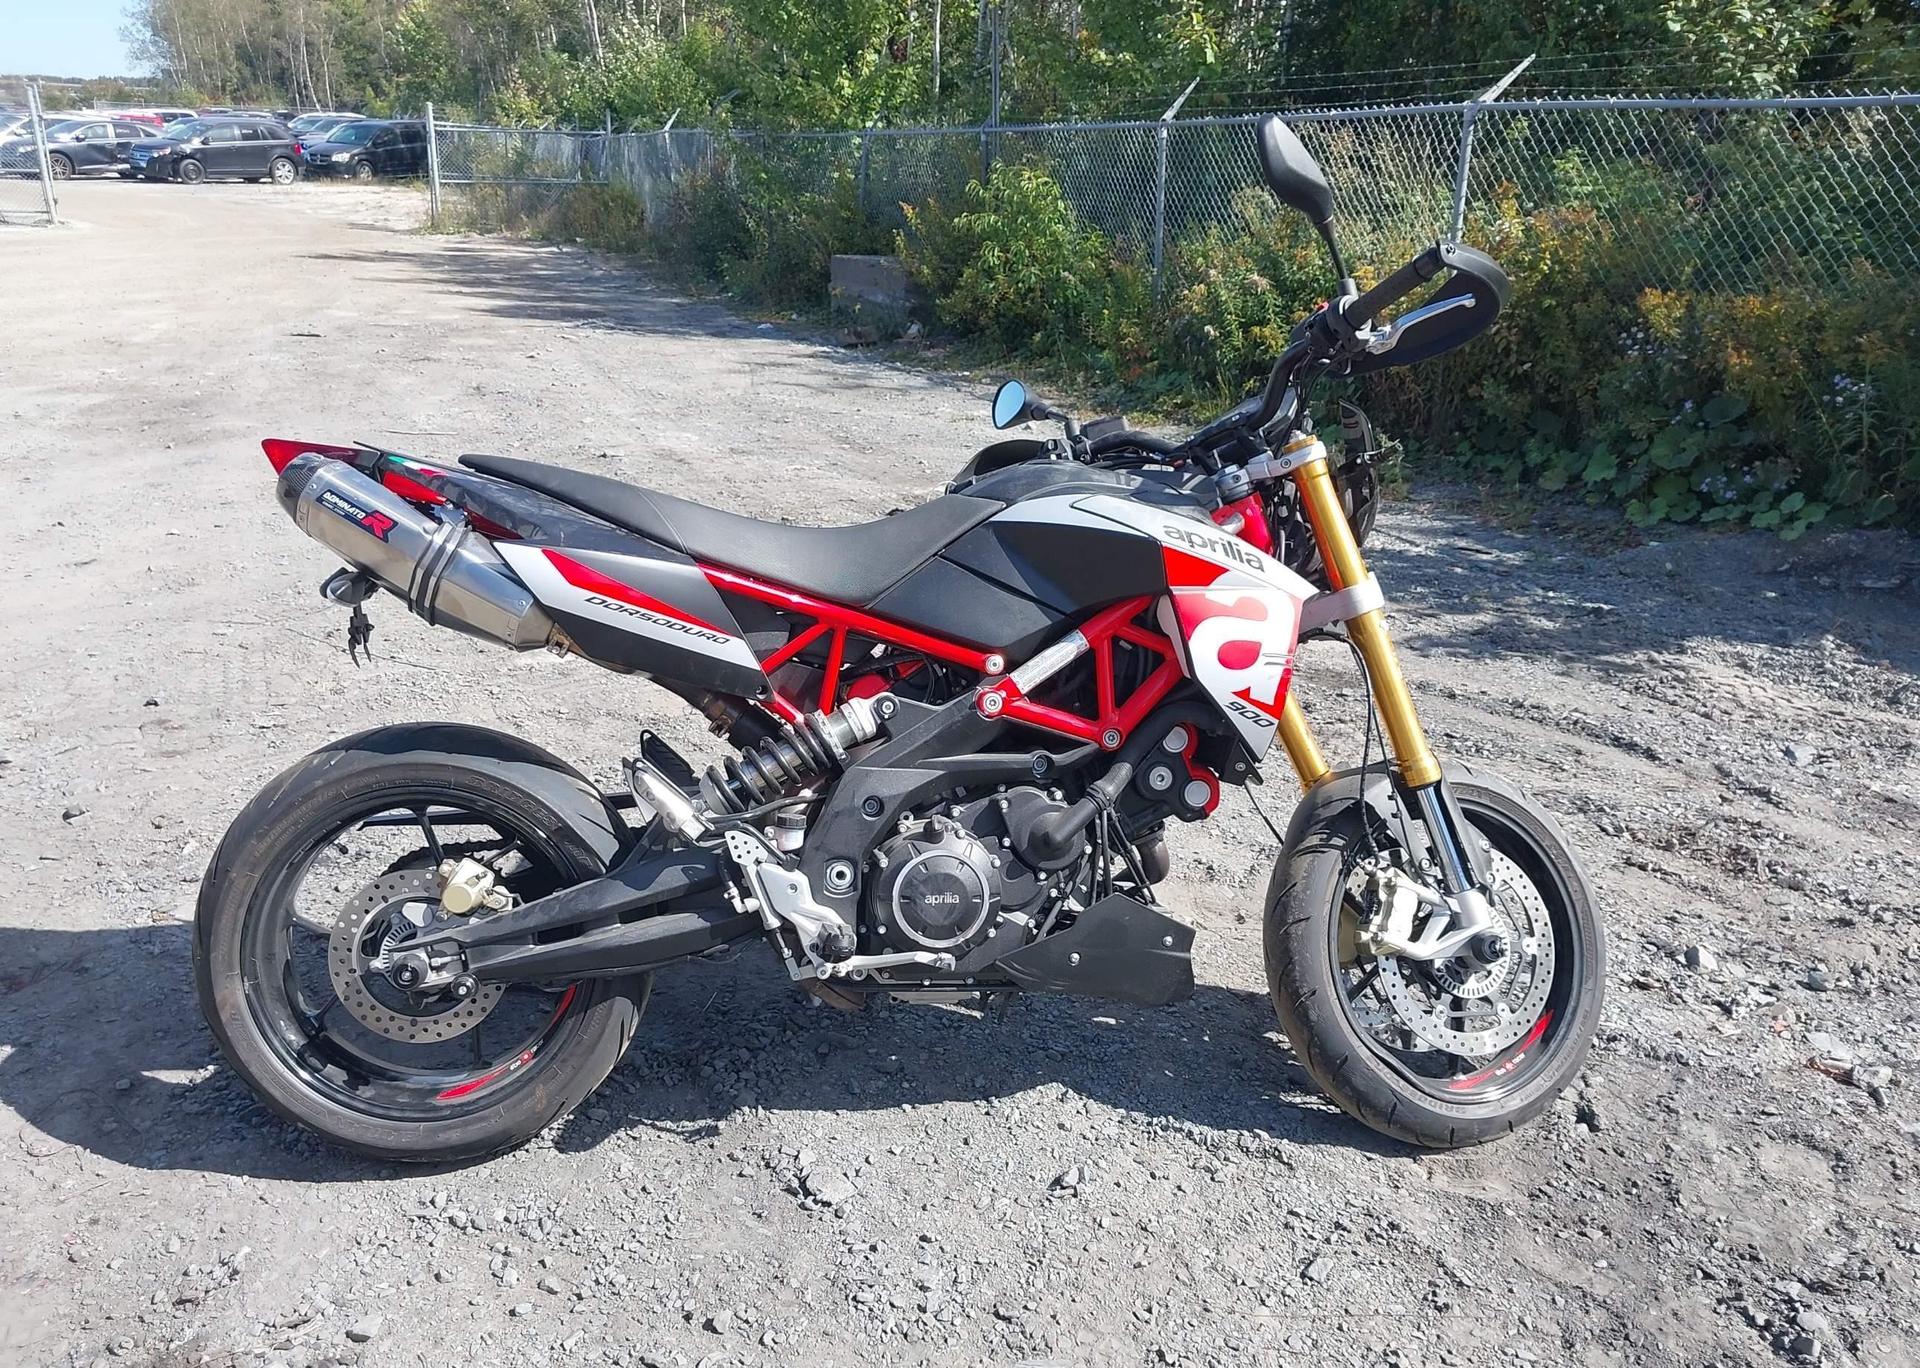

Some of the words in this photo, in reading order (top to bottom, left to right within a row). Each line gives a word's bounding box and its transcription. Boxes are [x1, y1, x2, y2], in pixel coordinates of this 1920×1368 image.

[1162, 525, 1265, 573] aprilia
[584, 596, 731, 645] DORSODURO
[1224, 701, 1275, 728] 900
[924, 891, 960, 907] aprilia
